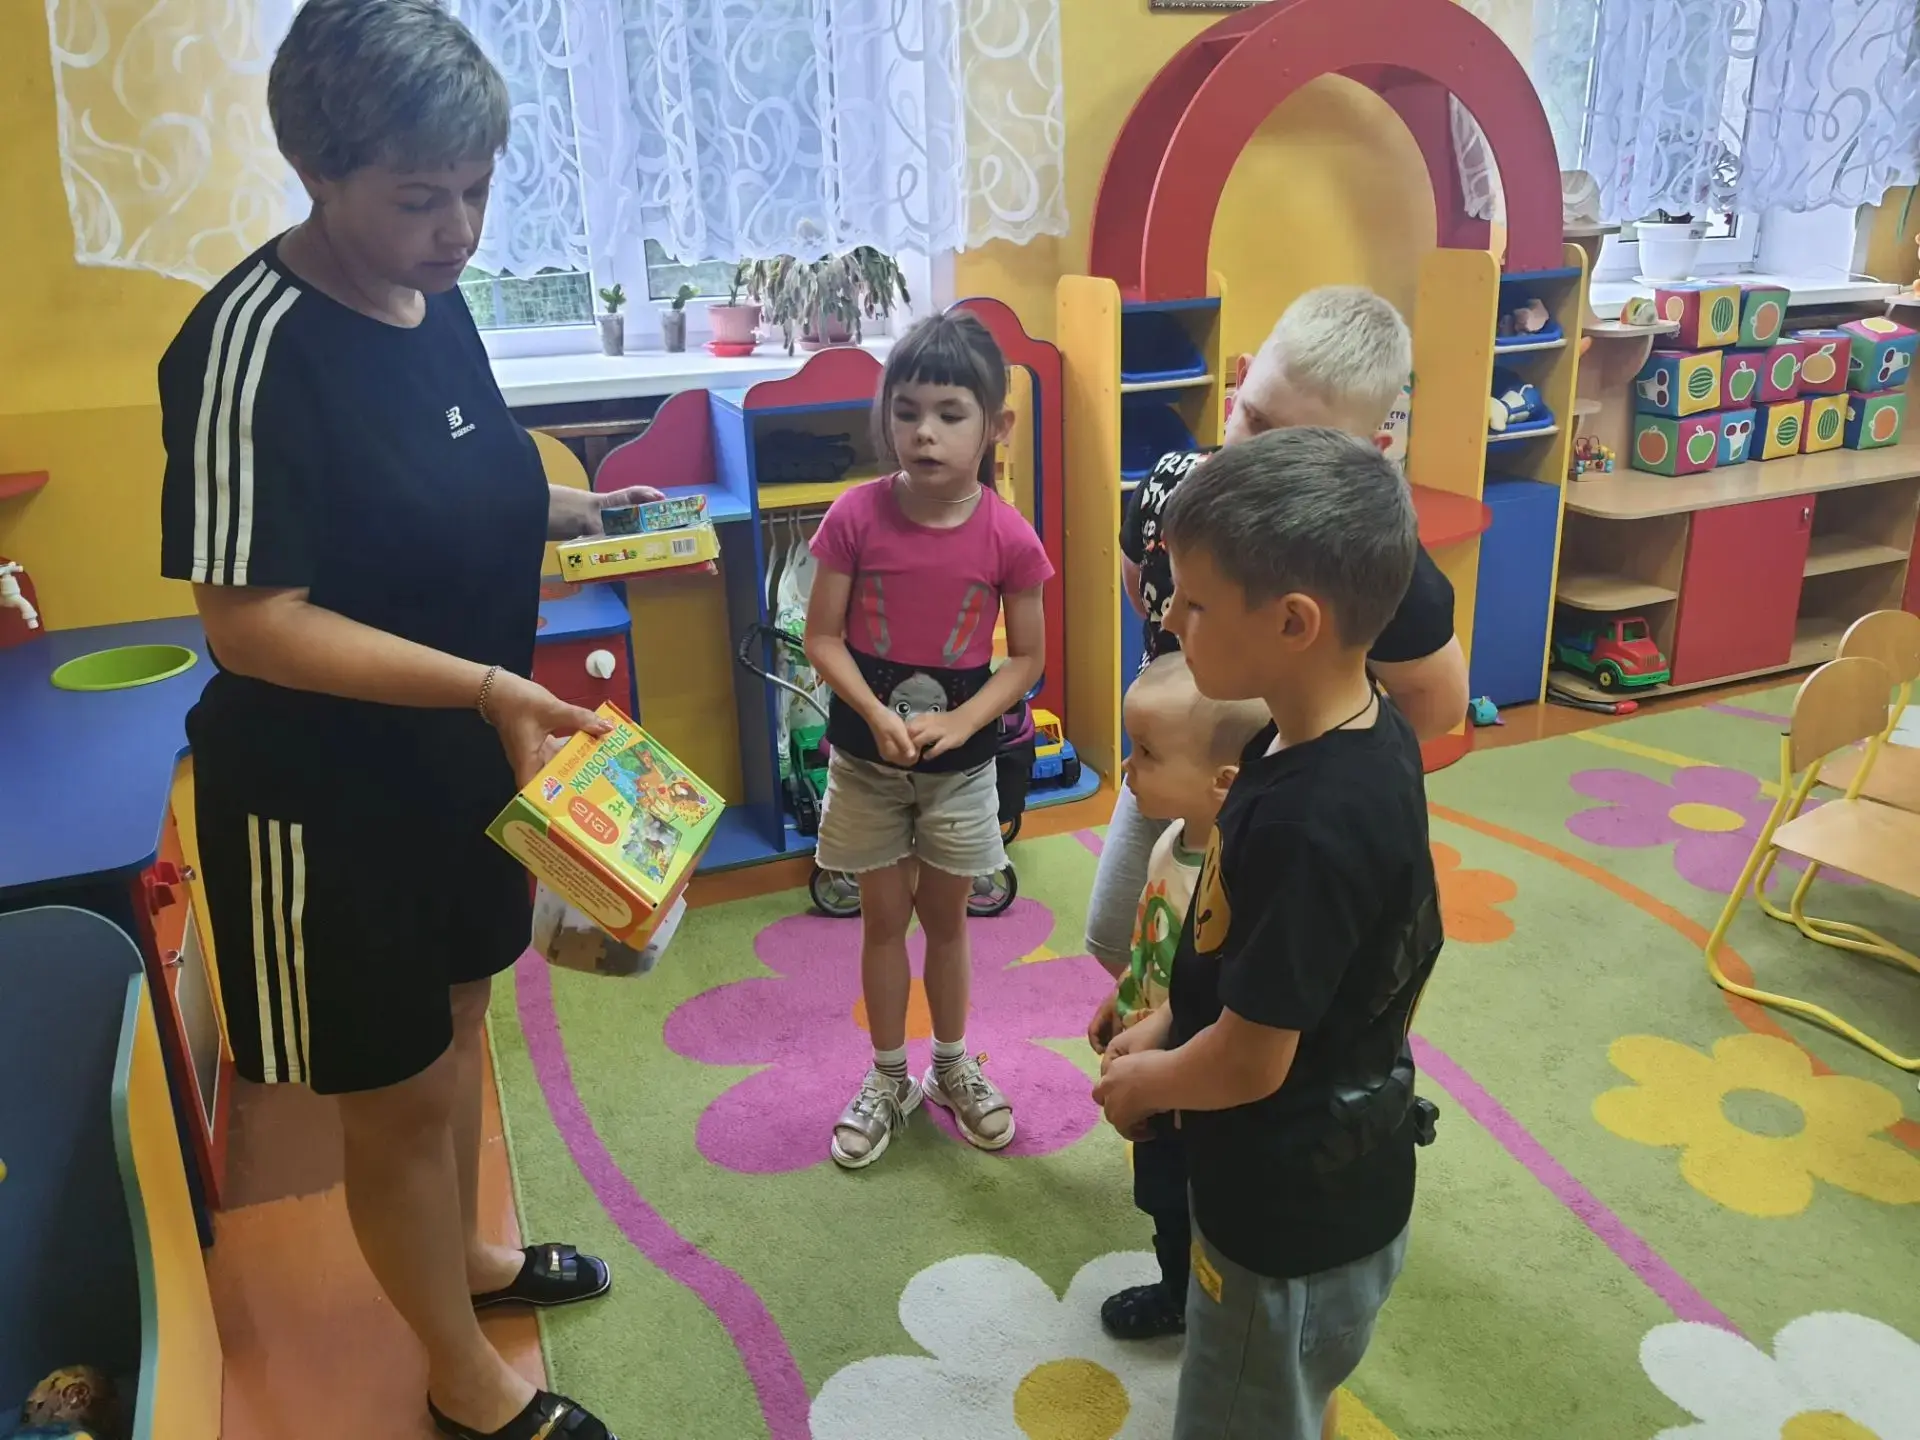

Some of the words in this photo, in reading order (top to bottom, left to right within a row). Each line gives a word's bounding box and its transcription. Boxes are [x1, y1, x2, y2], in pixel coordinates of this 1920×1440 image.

[569, 723, 632, 795] ЖИВОТНЫЕ
[572, 800, 588, 817] 10
[608, 799, 627, 817] 3+
[591, 816, 608, 832] 61
